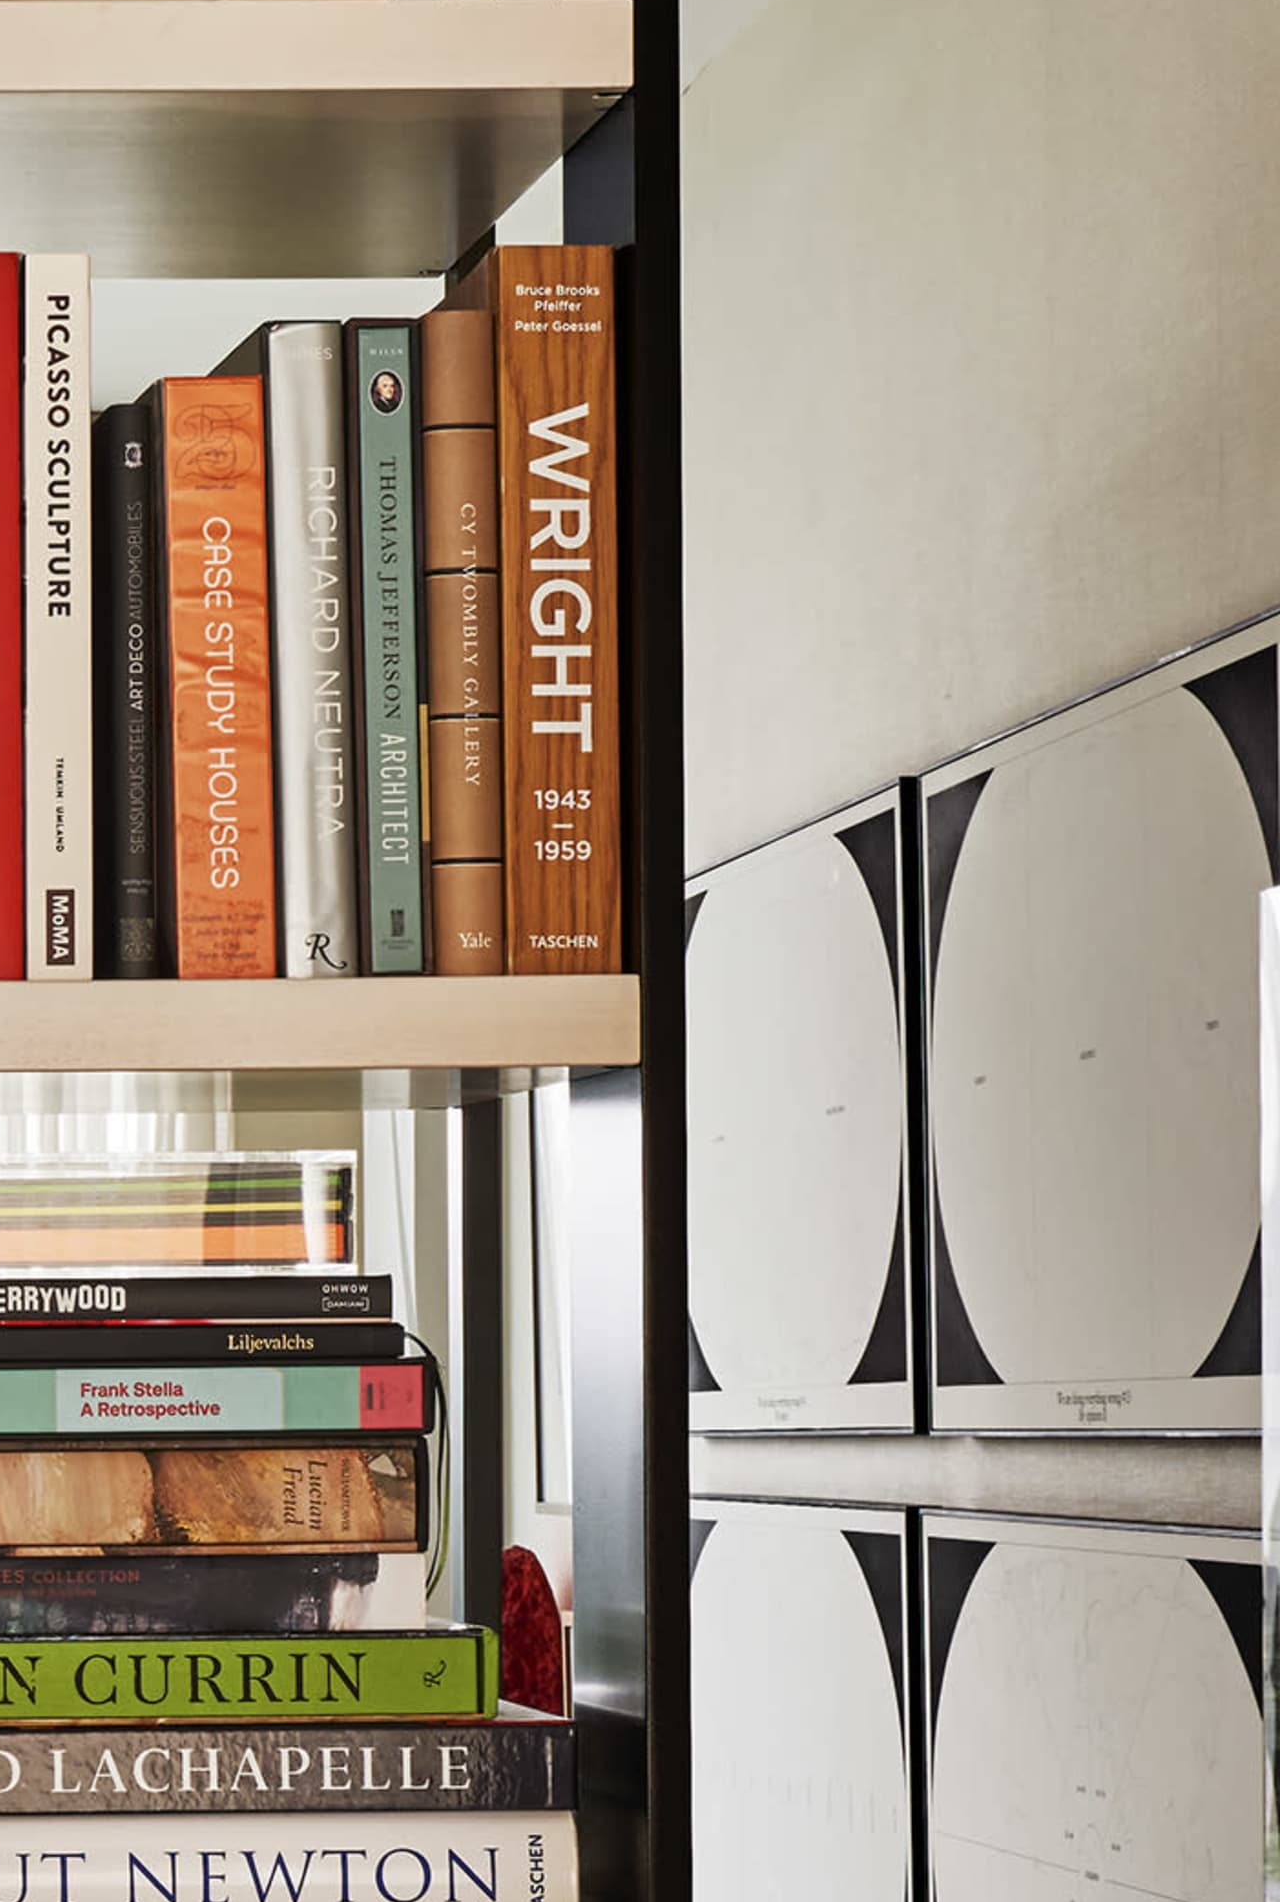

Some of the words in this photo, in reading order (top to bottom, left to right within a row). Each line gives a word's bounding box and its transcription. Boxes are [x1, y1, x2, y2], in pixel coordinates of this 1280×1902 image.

[48, 296, 69, 427] PICASSO
[48, 440, 70, 616] SCULPTURE
[380, 457, 397, 564] THOMAS
[127, 498, 145, 623] AUTOMOBILES
[201, 517, 234, 608] CASE
[304, 465, 341, 657] RICHARD
[526, 403, 594, 753] WRIGHT
[129, 624, 147, 673] DECO
[378, 572, 400, 718] JEFFERSON
[129, 679, 144, 710] ART
[202, 622, 238, 733] STUDY
[308, 666, 346, 843] NEUTRA
[206, 748, 240, 889] HOUSES
[380, 734, 408, 863] ARCHITECT
[534, 788, 592, 812] 1943
[535, 839, 591, 863] 1959
[459, 931, 492, 949] Yale
[528, 935, 600, 949] TASCHEN
[228, 1334, 314, 1353] Liljevalchs
[81, 1381, 129, 1400] Frank
[132, 1381, 185, 1400] Stella
[81, 1403, 93, 1416] A
[98, 1400, 220, 1419] Retrospective
[283, 1466, 303, 1524] Freud
[308, 1461, 328, 1530] Lucian
[31, 1569, 140, 1584] COLLECTION
[75, 1653, 366, 1705] CURRIN
[50, 1743, 475, 1797] LACHAPELLE
